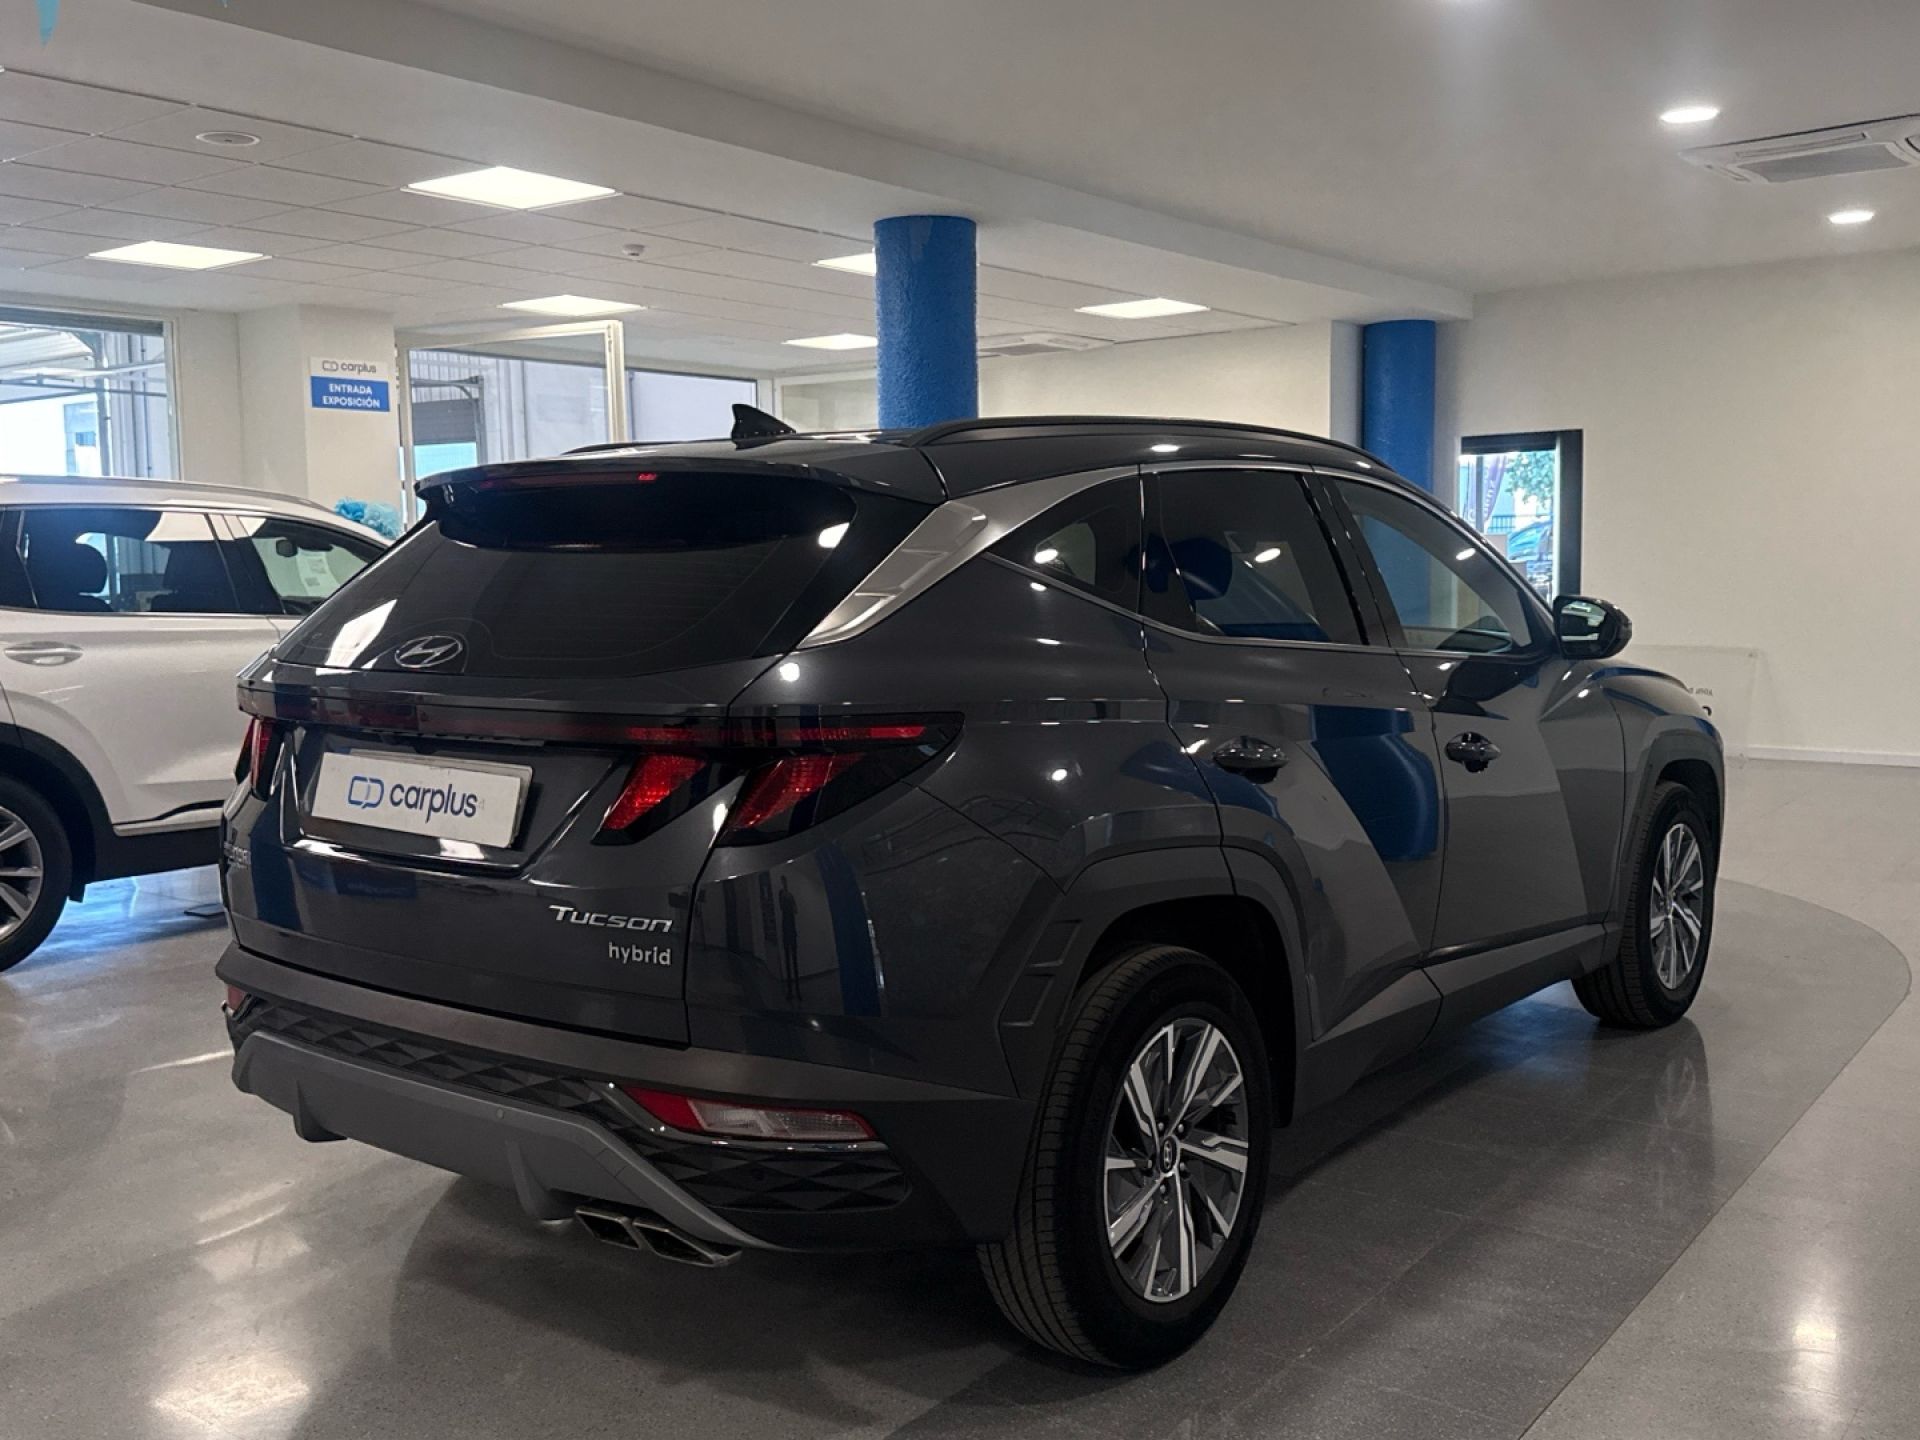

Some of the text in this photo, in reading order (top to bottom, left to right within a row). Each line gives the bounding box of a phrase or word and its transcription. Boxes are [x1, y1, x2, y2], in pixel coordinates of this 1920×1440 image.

[341, 362, 376, 375] carplus
[329, 383, 372, 395] ENTRADA
[322, 395, 380, 408] EXPOSICIÓN
[390, 783, 478, 824] carplus
[608, 941, 671, 966] hybrid
